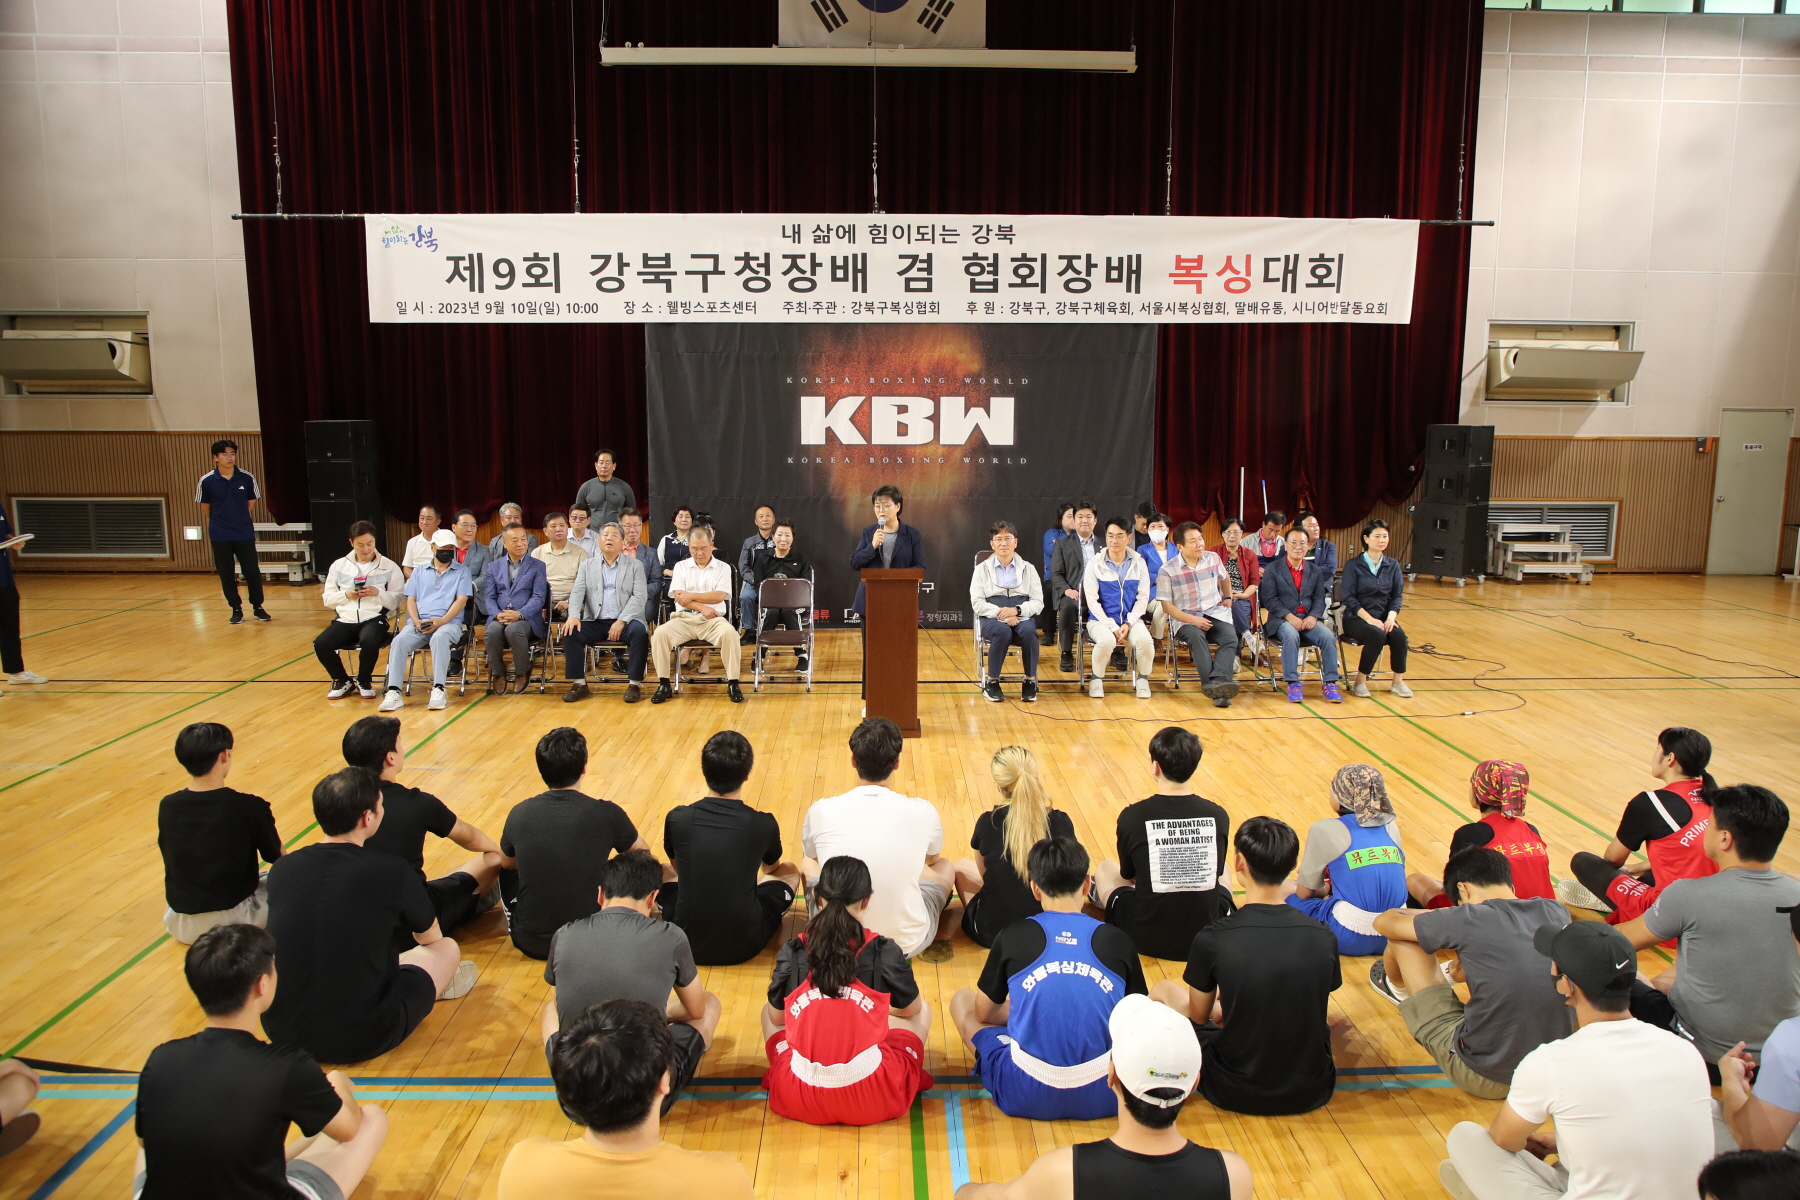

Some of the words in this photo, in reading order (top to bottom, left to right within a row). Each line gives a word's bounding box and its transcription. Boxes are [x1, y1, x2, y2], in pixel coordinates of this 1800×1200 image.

[408, 224, 439, 253] 강북
[781, 223, 802, 245] 내
[811, 223, 856, 245] 삶에
[867, 223, 961, 245] 힘이되는
[971, 223, 1017, 245] 강북
[445, 251, 562, 294] 제9회
[589, 251, 868, 294] 강북구청장배
[896, 252, 933, 293] 겸
[961, 251, 1142, 295] 협회장배
[1168, 252, 1345, 295] 복싱대회
[396, 301, 408, 315] 일
[413, 301, 424, 315] 시
[438, 300, 480, 315] 2023년
[485, 301, 505, 315] 9월
[510, 301, 560, 316] 10일(일)
[566, 302, 599, 314] 10:00
[623, 300, 636, 315] 장
[641, 301, 654, 313] 소
[666, 300, 757, 315] 웰빙스포츠센터
[851, 300, 940, 315] 강북구복싱협회
[965, 301, 979, 315] 후
[983, 301, 995, 315] 원
[1009, 301, 1050, 316] 강북구,
[1055, 301, 1134, 316] 강북구체육회,
[1139, 301, 1230, 316] 서울시복싱협회,
[1234, 301, 1287, 316] 딸배유통,
[1291, 301, 1389, 316] 시니어반달동요회
[786, 377, 851, 385] KOREA
[869, 377, 946, 385] BOXING
[963, 377, 1029, 385] WORLD
[800, 395, 1015, 446] KBW
[962, 457, 1028, 465] WORLD
[917, 582, 935, 594] 구
[926, 613, 958, 622] 정형외과
[1151, 821, 1166, 831] THE
[1167, 819, 1214, 829] ADVANTAGES
[1167, 829, 1177, 837] OF
[1179, 828, 1201, 836] BEING
[1155, 838, 1161, 846] A
[1161, 836, 1190, 846] WOMAN
[1191, 835, 1214, 844] ARTIST
[789, 985, 875, 1020] 와룡복체육관
